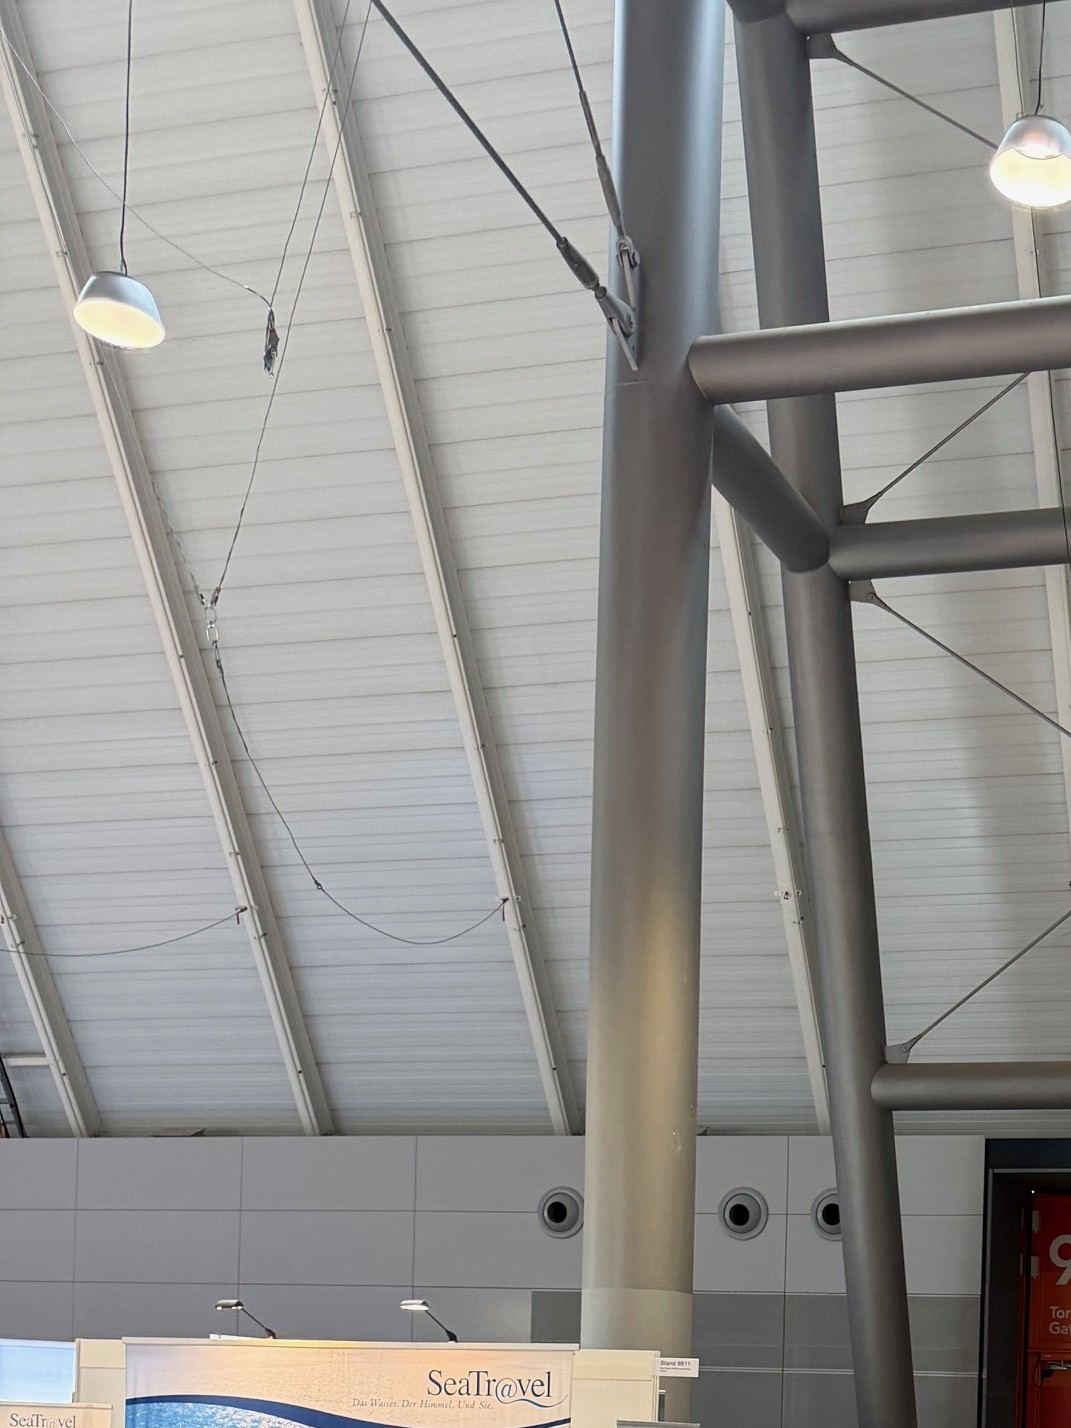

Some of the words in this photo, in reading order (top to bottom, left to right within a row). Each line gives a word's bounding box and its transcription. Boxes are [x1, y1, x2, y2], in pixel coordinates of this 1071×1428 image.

[1049, 1306, 1071, 1320] Tor
[427, 1369, 560, 1406] SeaTr@vel
[352, 1398, 368, 1407] Das
[401, 1399, 417, 1408] Der
[457, 1401, 476, 1410] Und
